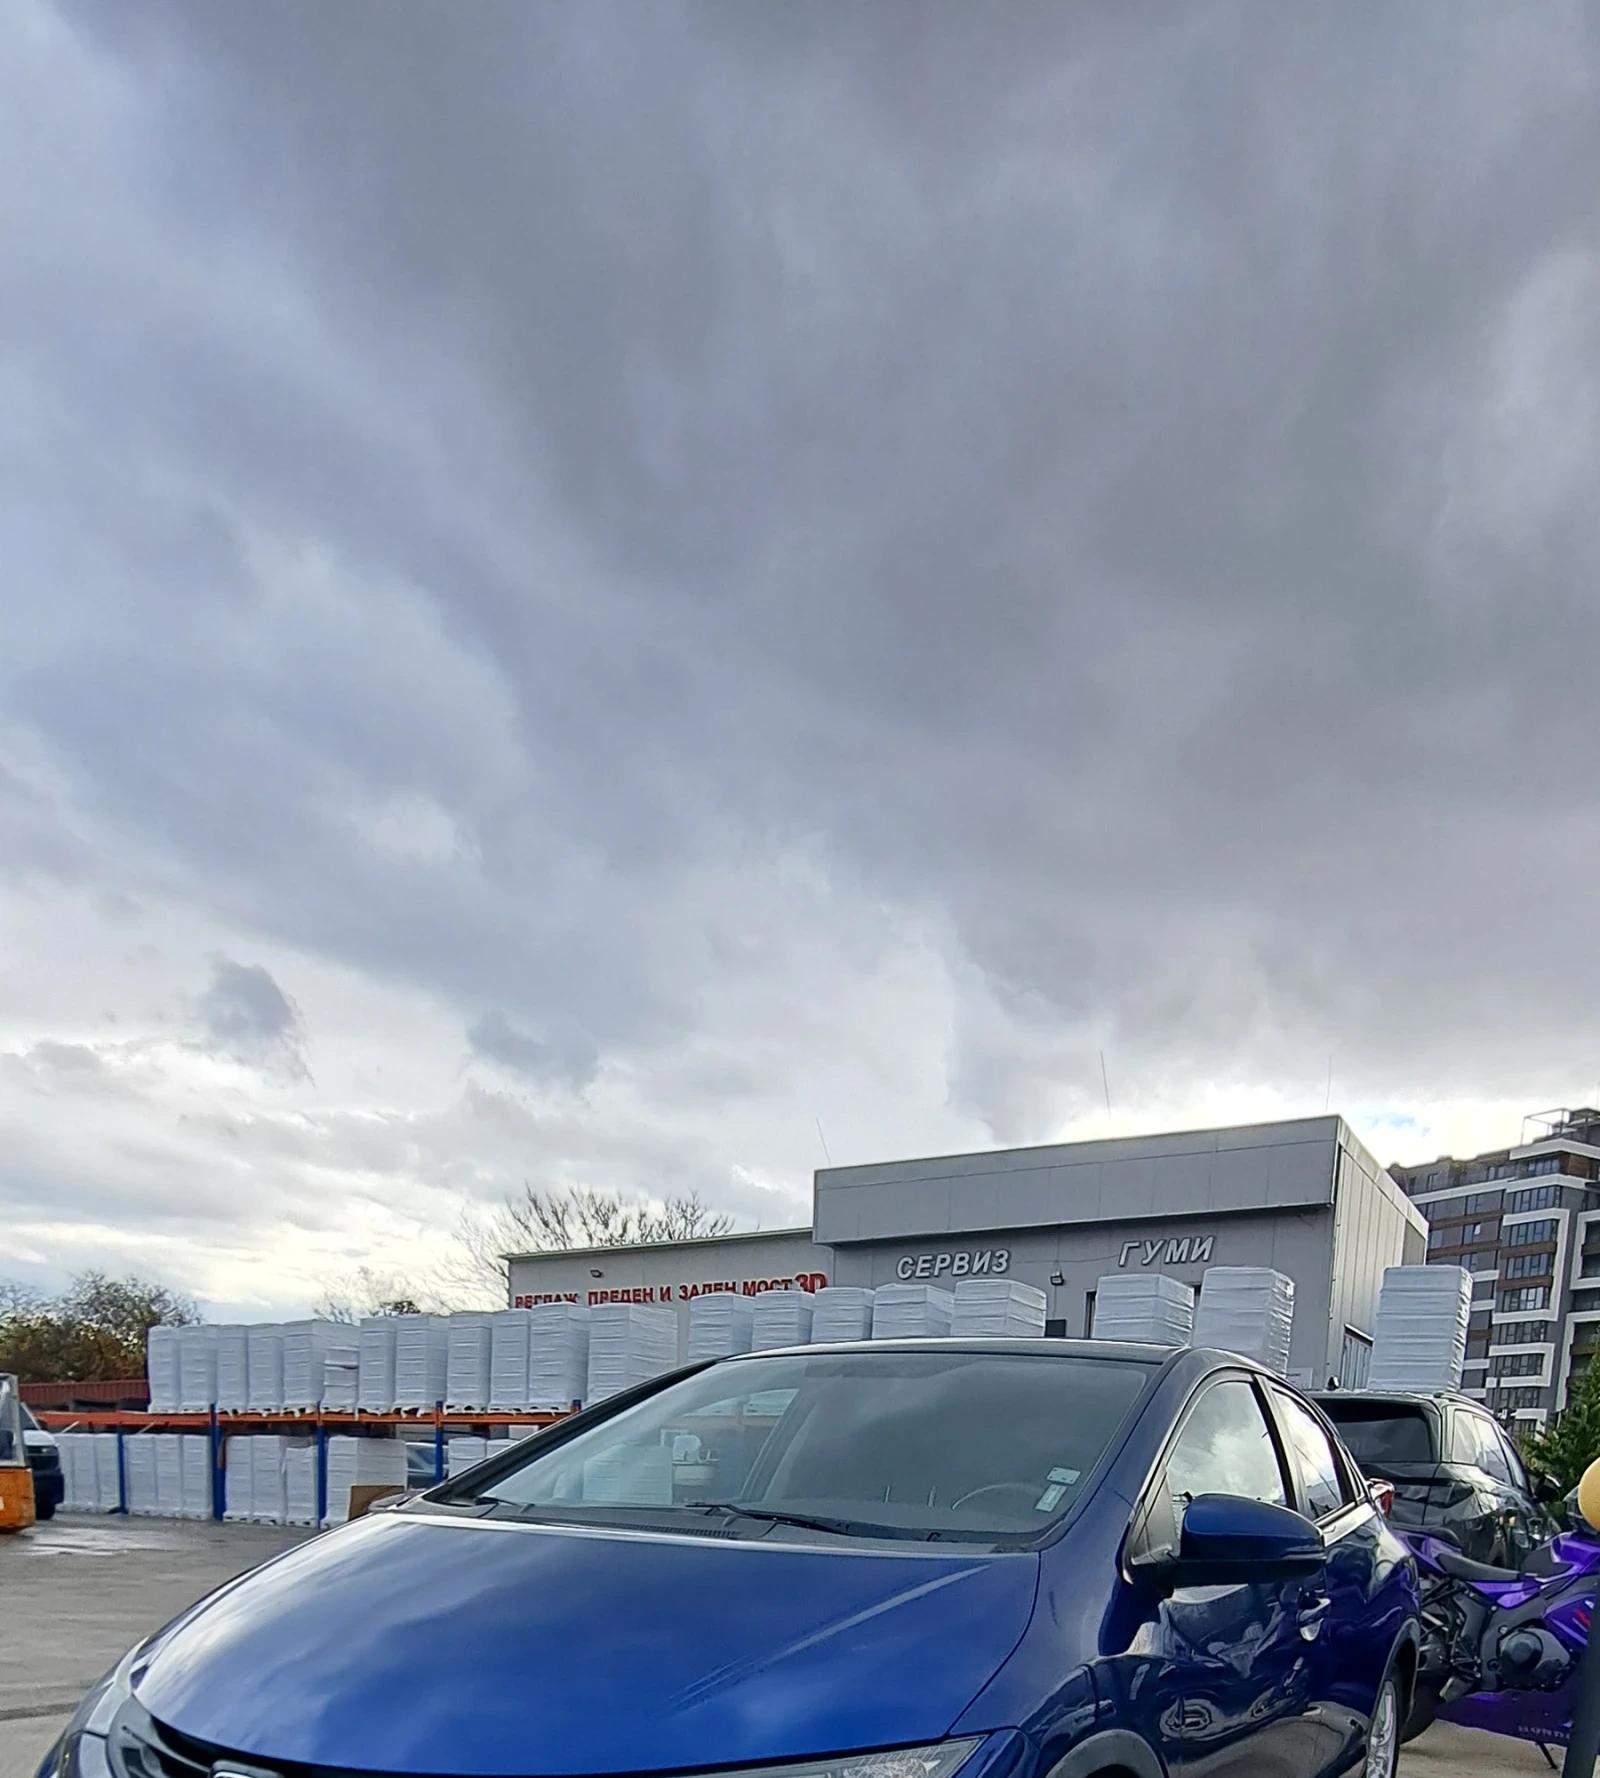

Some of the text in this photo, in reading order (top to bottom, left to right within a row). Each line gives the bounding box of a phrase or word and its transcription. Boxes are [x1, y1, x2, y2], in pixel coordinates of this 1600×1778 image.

[896, 1249, 1010, 1280] СЕРВИЗ
[1118, 1235, 1216, 1267] ГУМИ
[587, 1286, 655, 1306] ПРЕДЕН
[660, 1285, 672, 1303] И
[742, 1278, 793, 1298] МОСТ
[794, 1272, 828, 1295] 3D
